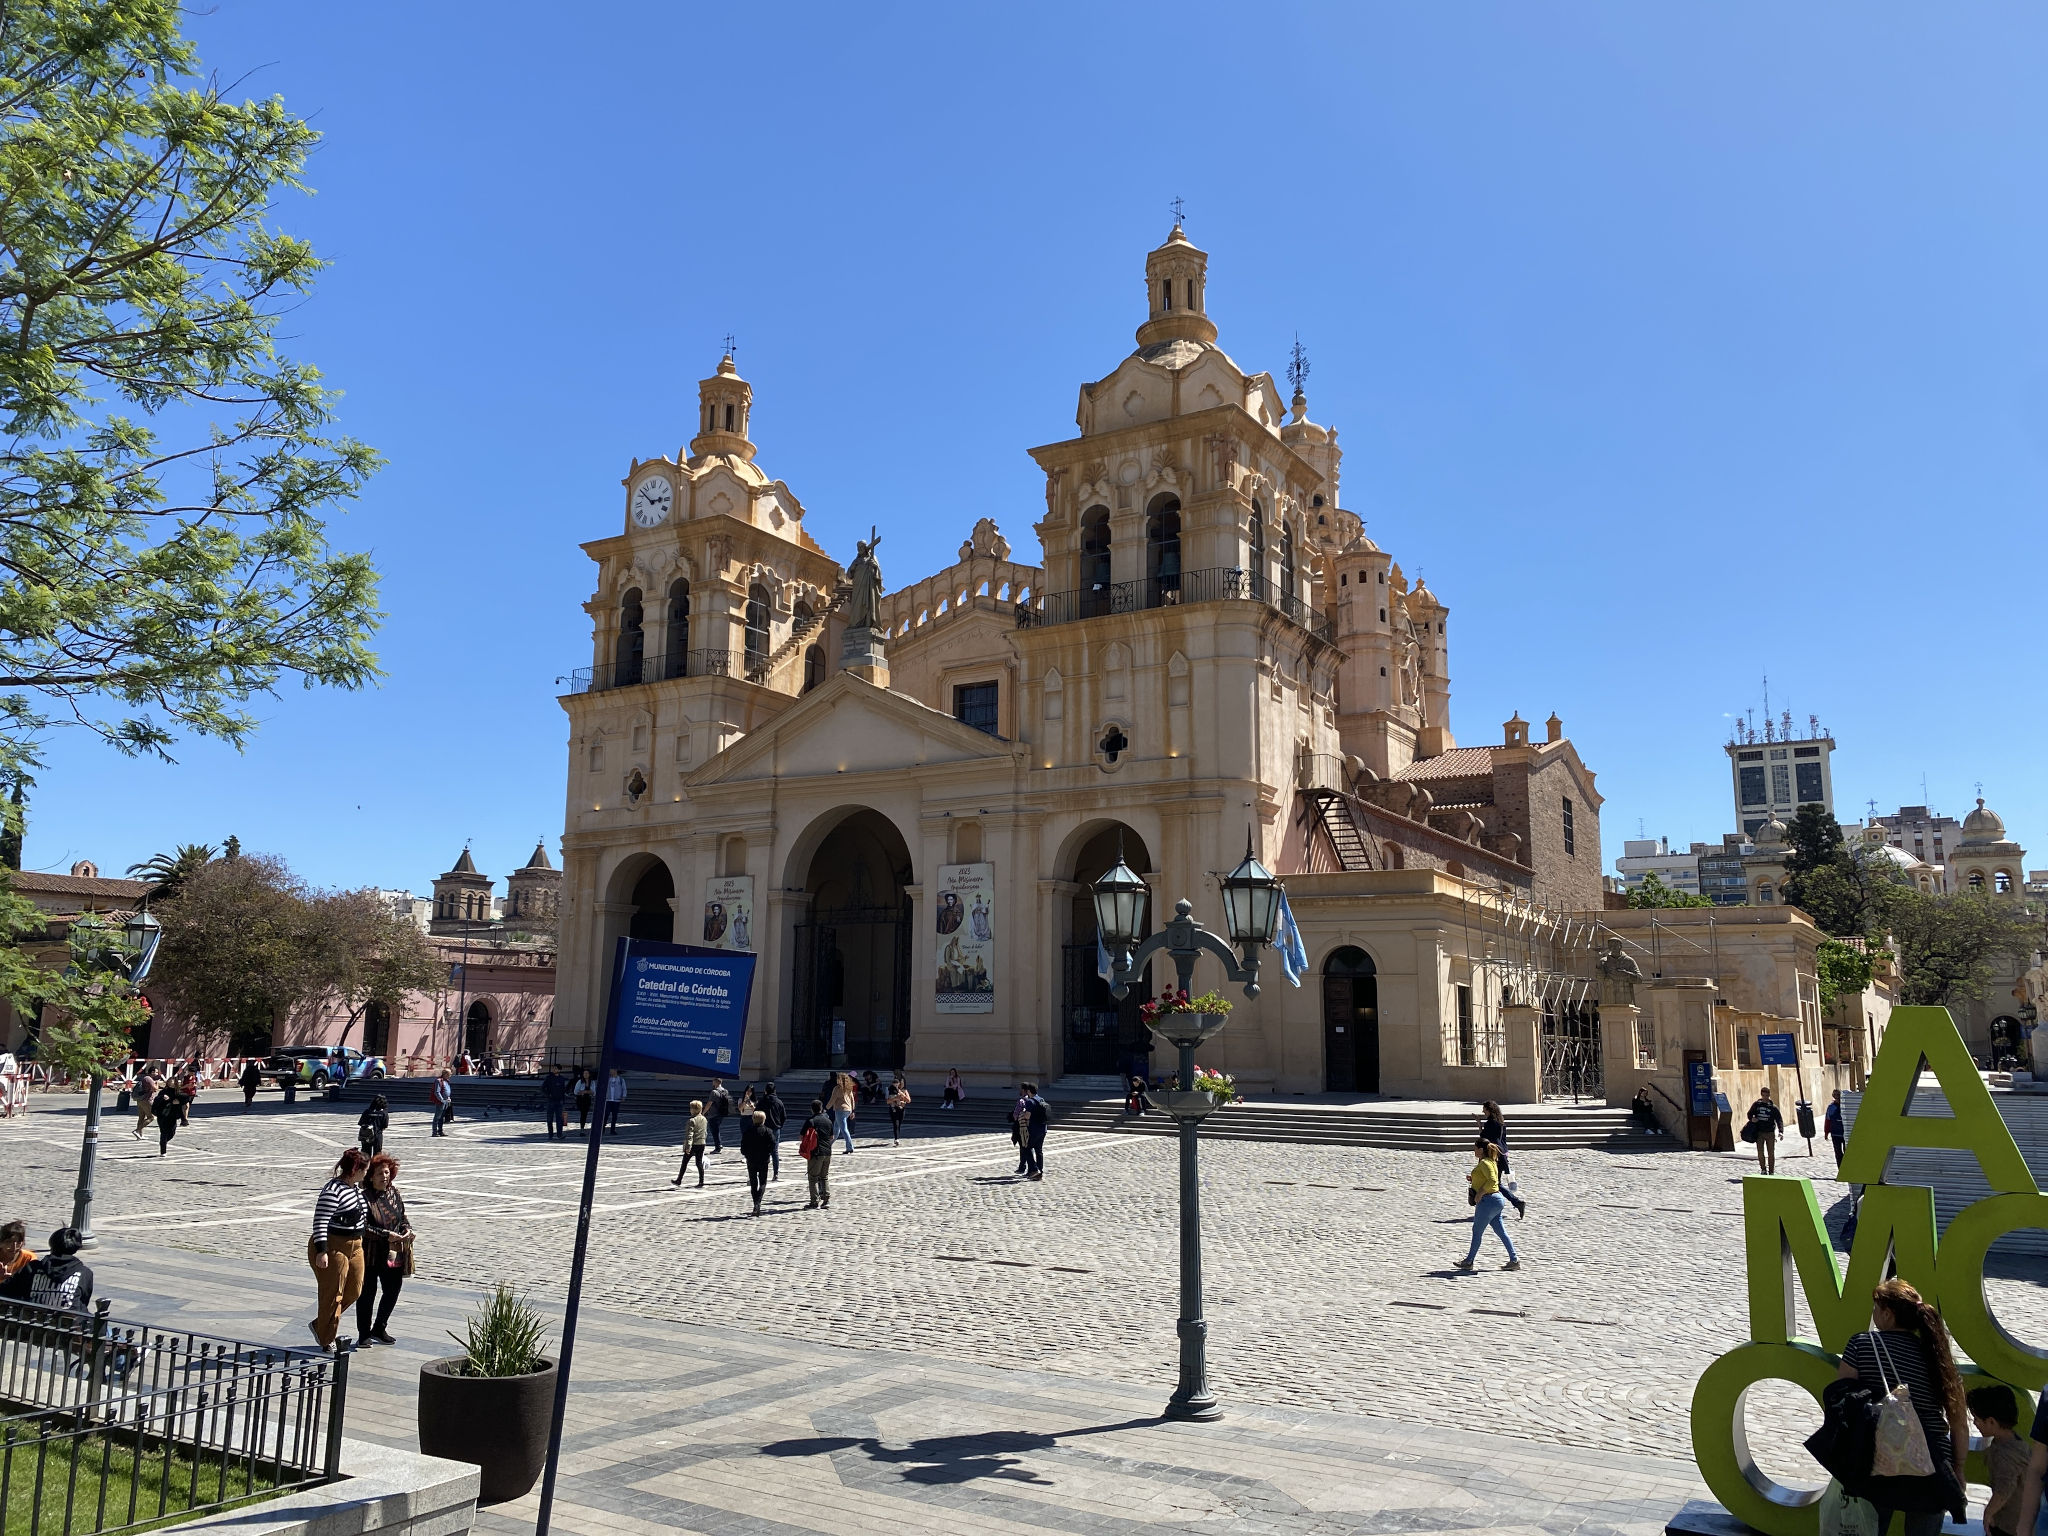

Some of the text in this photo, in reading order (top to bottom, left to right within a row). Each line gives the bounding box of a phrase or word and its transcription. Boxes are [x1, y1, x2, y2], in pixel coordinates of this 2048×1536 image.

[648, 963, 731, 977] MUNICIPALIDAD DE CÓRDOBA
[638, 978, 728, 997] Catedral de Córdoba
[633, 1015, 690, 1028] Córdoba Cathedral
[1837, 1006, 2039, 1193] A
